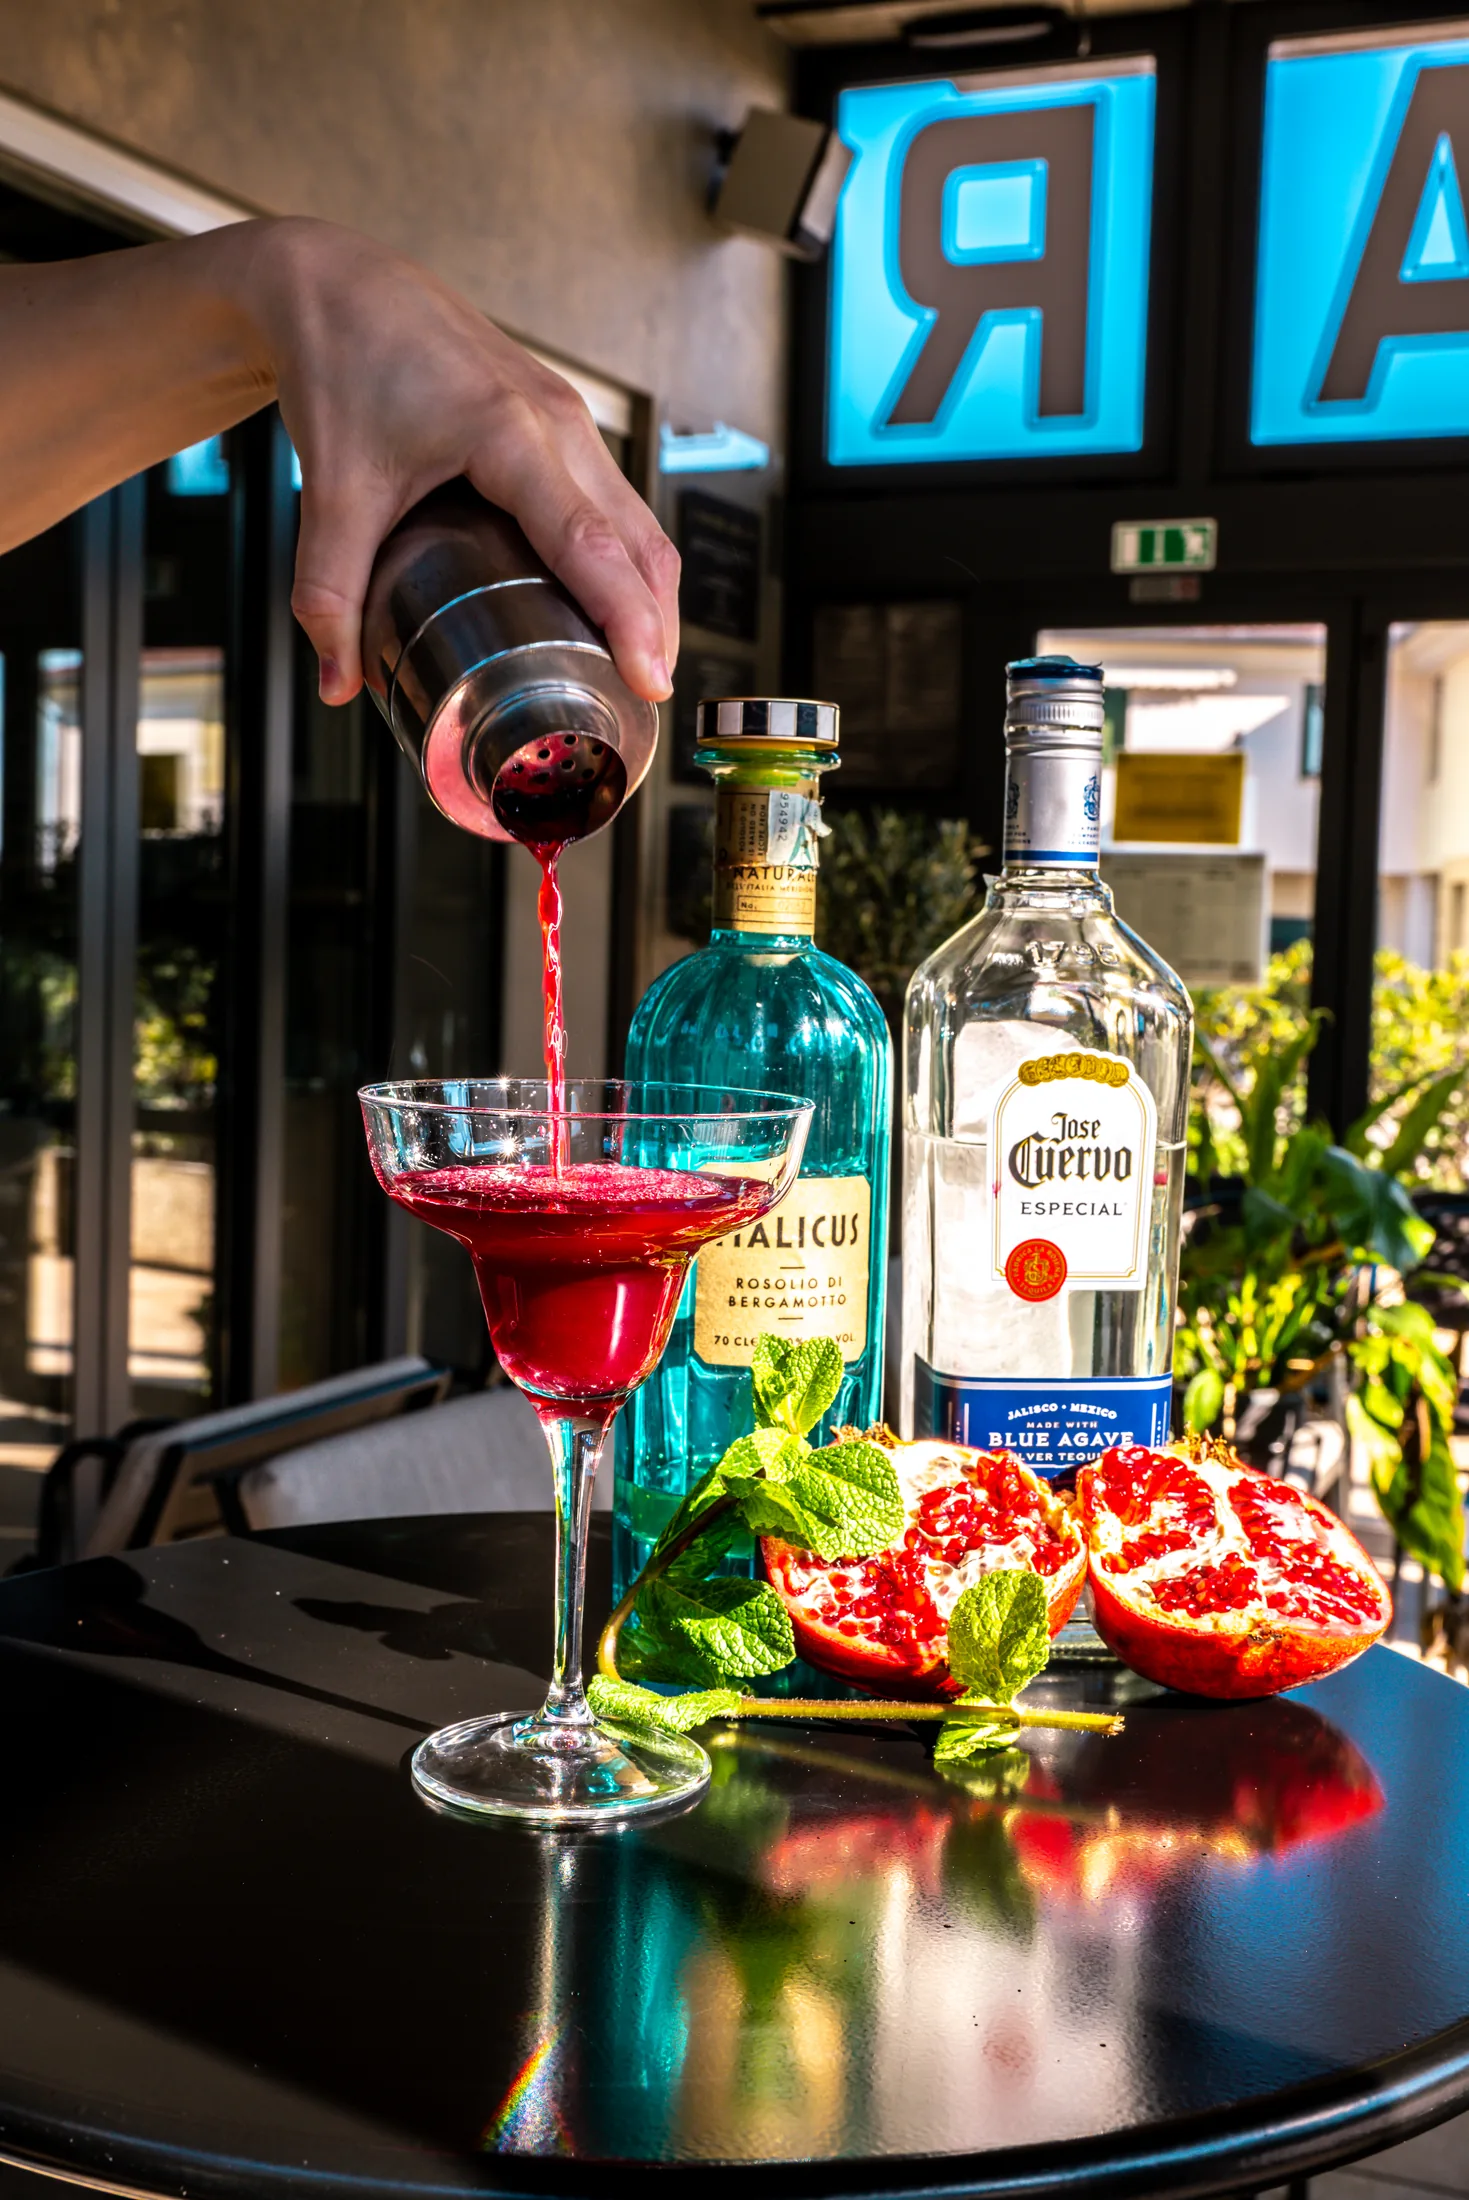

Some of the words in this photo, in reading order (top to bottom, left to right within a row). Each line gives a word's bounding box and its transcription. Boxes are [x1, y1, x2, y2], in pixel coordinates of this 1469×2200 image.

[1051, 1112, 1102, 1144] Jose
[1008, 1131, 1133, 1190] Cuervo
[1020, 1201, 1124, 1217] ESPECIAL
[735, 1277, 819, 1290] ROSOLIO
[827, 1275, 843, 1289] DI
[728, 1293, 848, 1309] BERGAMOTTO
[714, 1335, 729, 1346] 70
[1007, 1402, 1059, 1421] JALISCO
[1069, 1402, 1118, 1420] MEXICO
[1026, 1421, 1060, 1429] MADE
[1066, 1420, 1099, 1429] WITH
[988, 1431, 1051, 1447] BLUE
[1057, 1431, 1135, 1447] AGAVE
